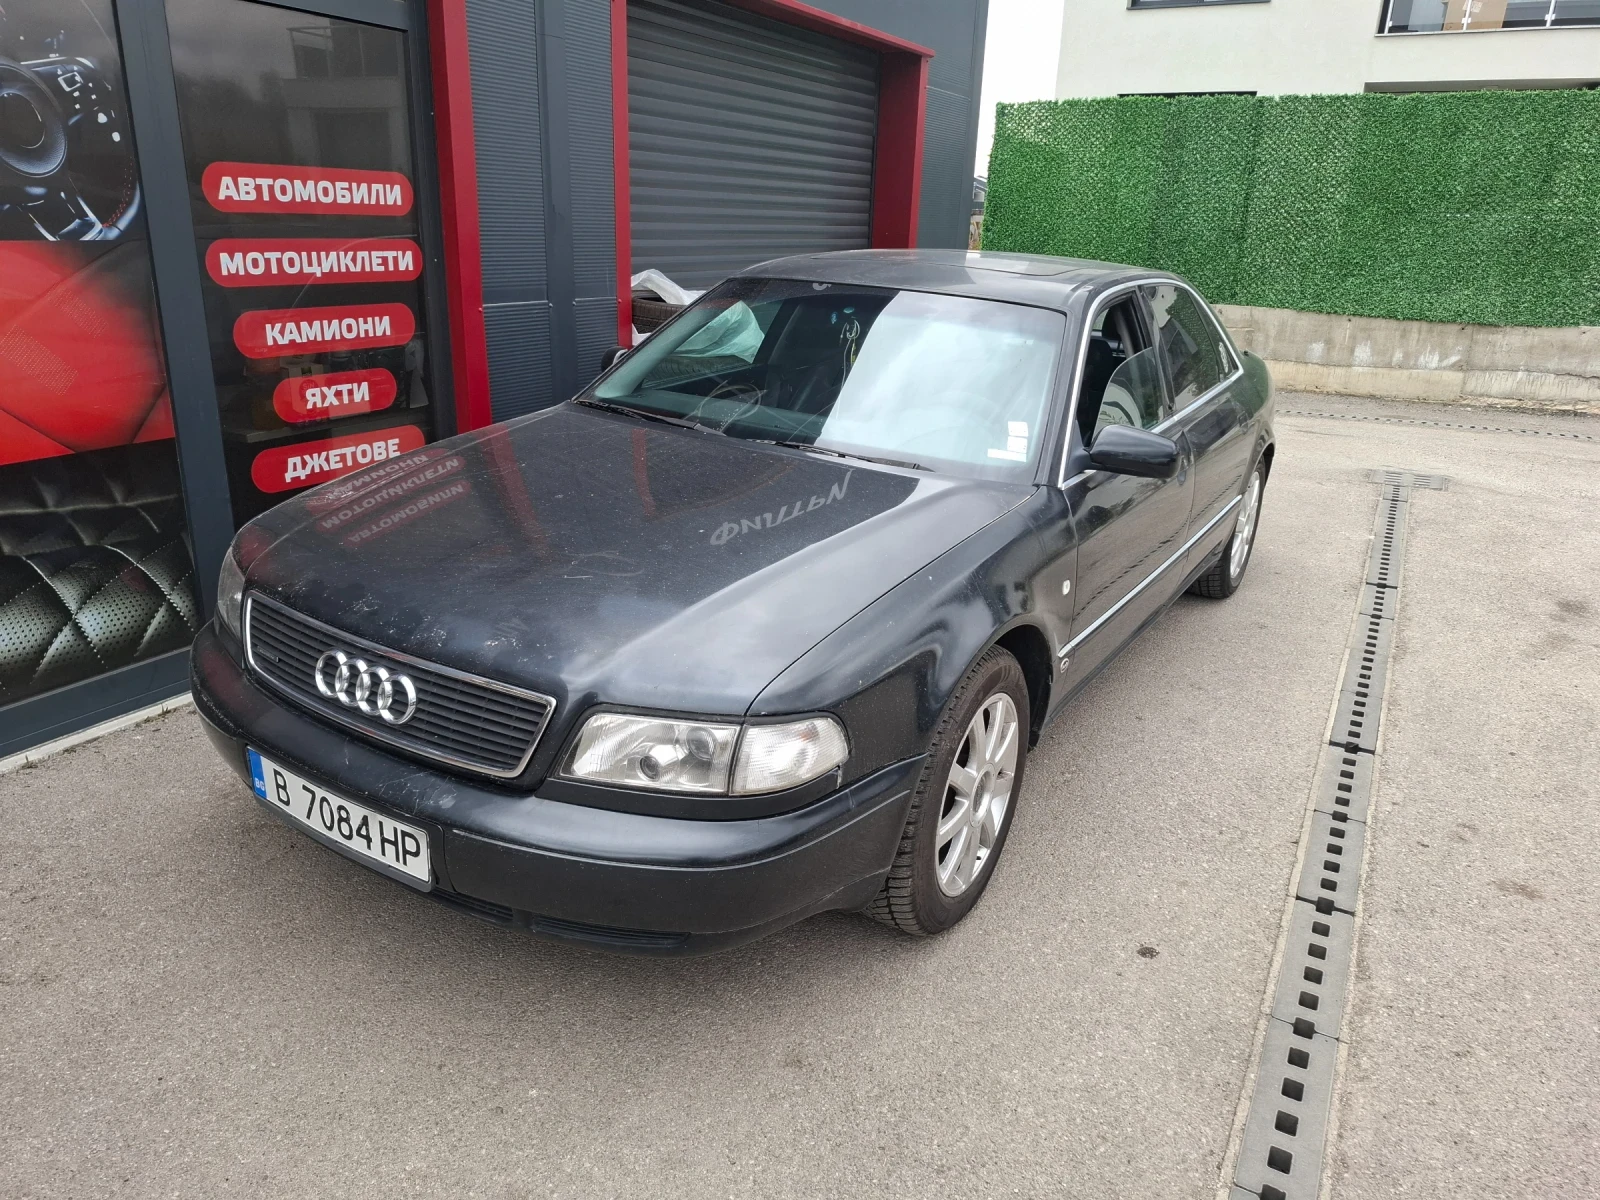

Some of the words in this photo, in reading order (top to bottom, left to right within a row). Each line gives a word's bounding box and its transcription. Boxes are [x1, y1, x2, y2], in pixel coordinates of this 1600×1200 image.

[218, 176, 402, 206] АВТОМОБИЛИ
[219, 250, 414, 277] МОТОЦИКЛЕТИ
[265, 315, 391, 346] КАМИОНИ
[305, 381, 370, 410] ЯХТИ
[284, 438, 401, 483] ДЖЕТОВЕ
[254, 776, 266, 792] BG
[272, 767, 291, 807] B
[302, 784, 373, 851] 7084
[378, 820, 421, 866] HP
